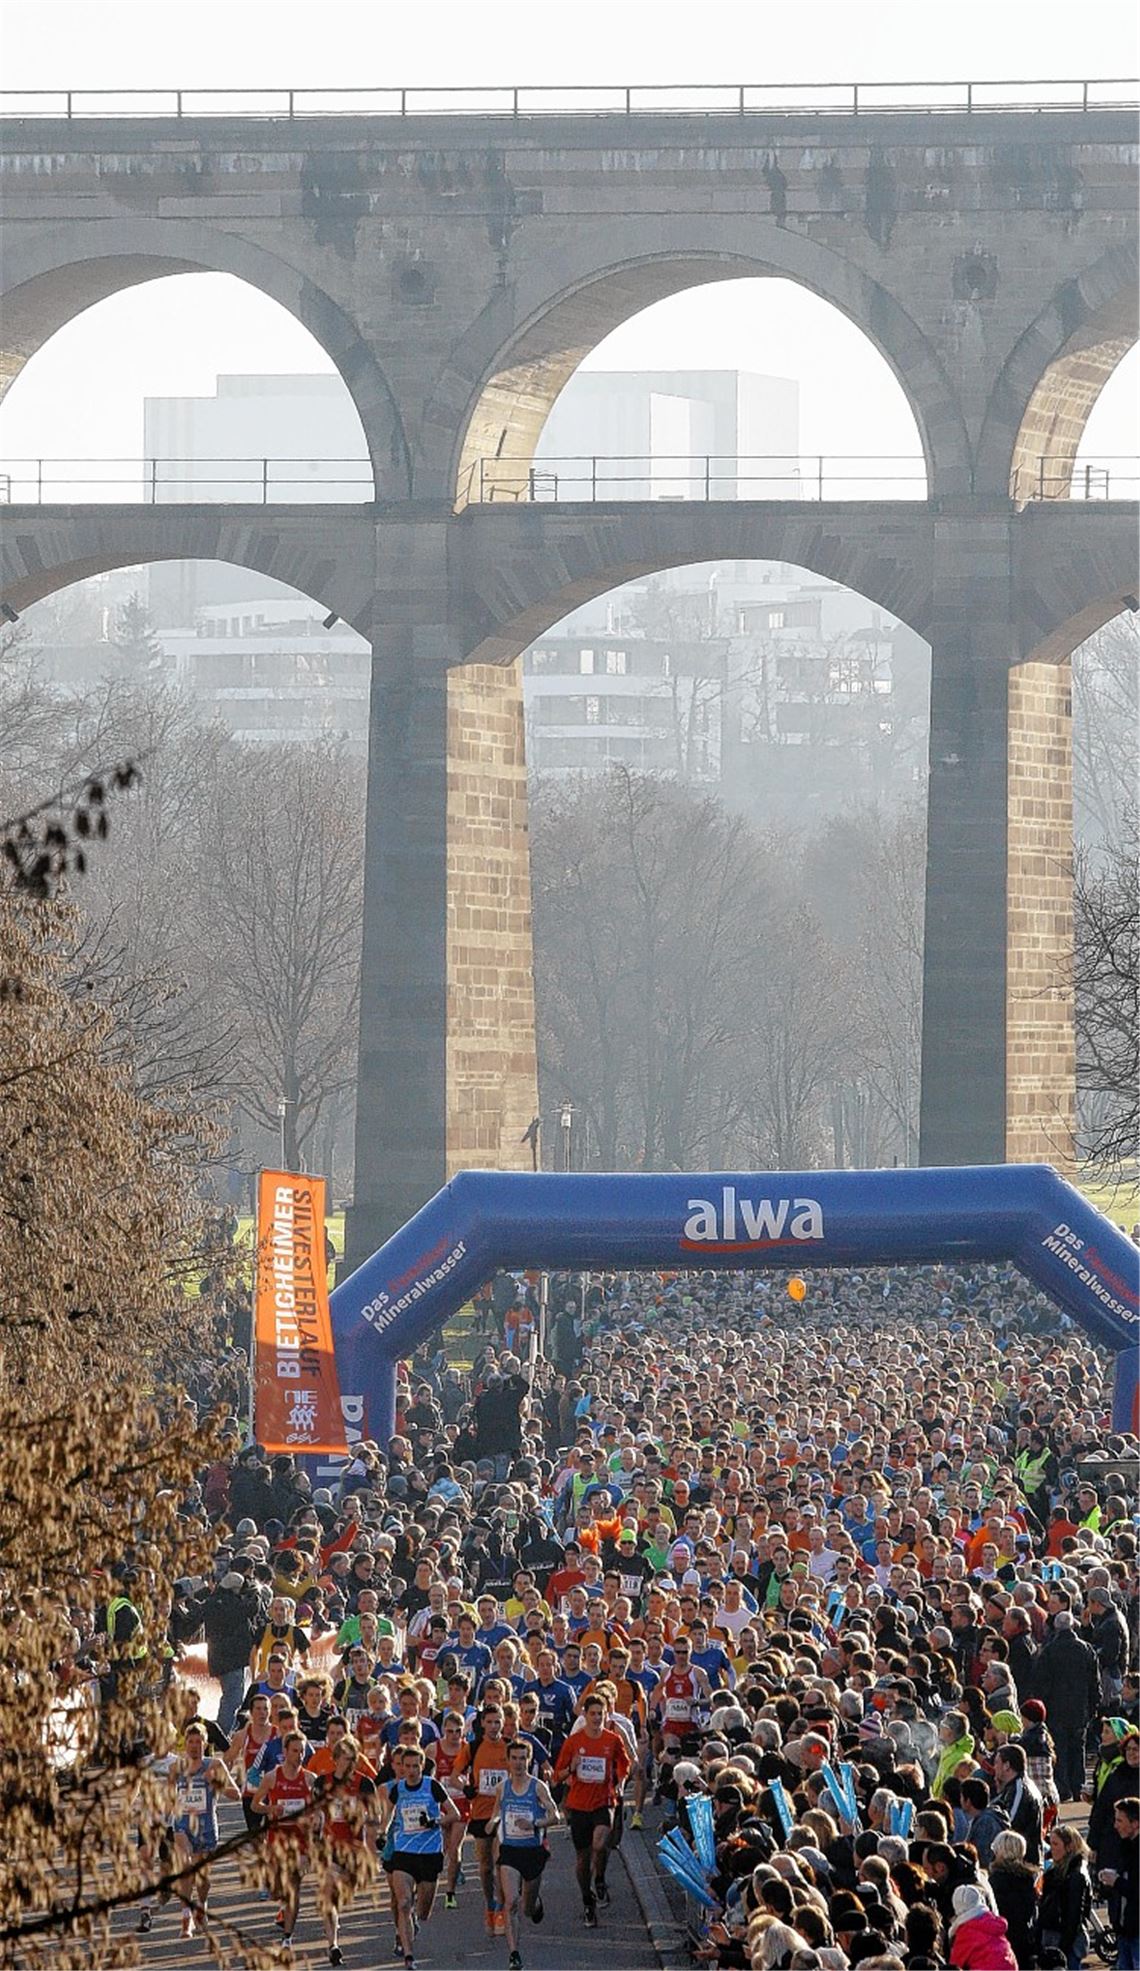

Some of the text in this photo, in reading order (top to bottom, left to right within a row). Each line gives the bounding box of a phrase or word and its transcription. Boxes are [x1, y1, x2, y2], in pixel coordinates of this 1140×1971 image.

[684, 1186, 825, 1240] alwa
[1054, 1223, 1085, 1251] Das
[273, 1185, 300, 1378] BIETIGHEIMER
[293, 1188, 321, 1377] SILVESTERLAUF
[361, 1291, 390, 1322] Das
[373, 1240, 467, 1334] Mineralwasser
[1041, 1236, 1140, 1324] Mineralwasser
